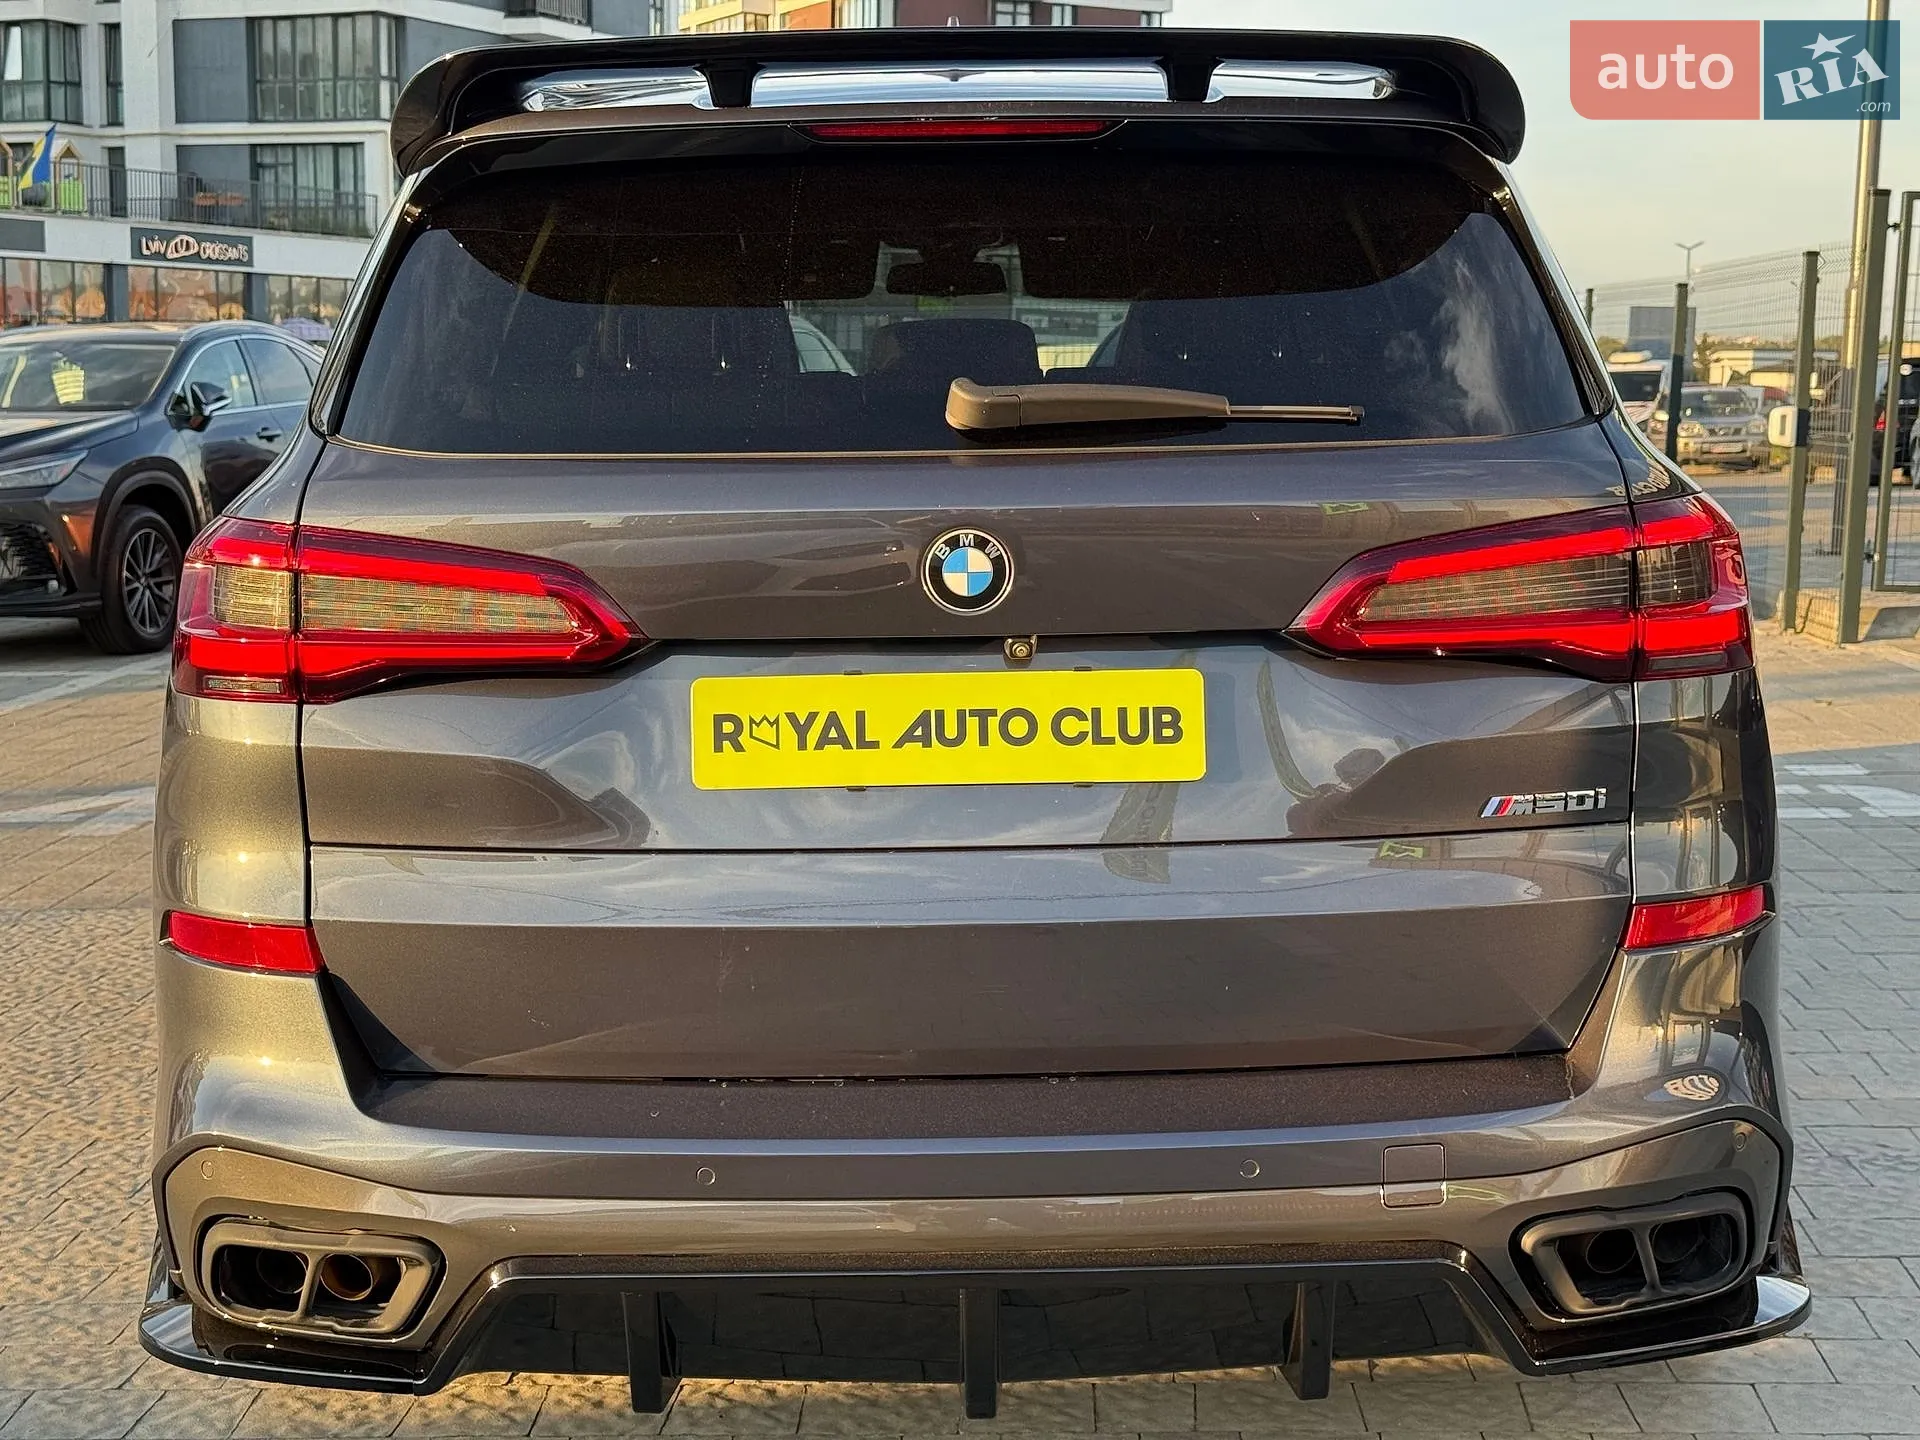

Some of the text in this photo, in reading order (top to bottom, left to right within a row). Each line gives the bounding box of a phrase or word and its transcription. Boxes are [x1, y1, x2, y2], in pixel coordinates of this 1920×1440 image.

[934, 533, 1001, 560] BMW
[891, 707, 1039, 749] AUTO
[1050, 706, 1184, 746] CLUB
[1507, 787, 1607, 816] M50i
